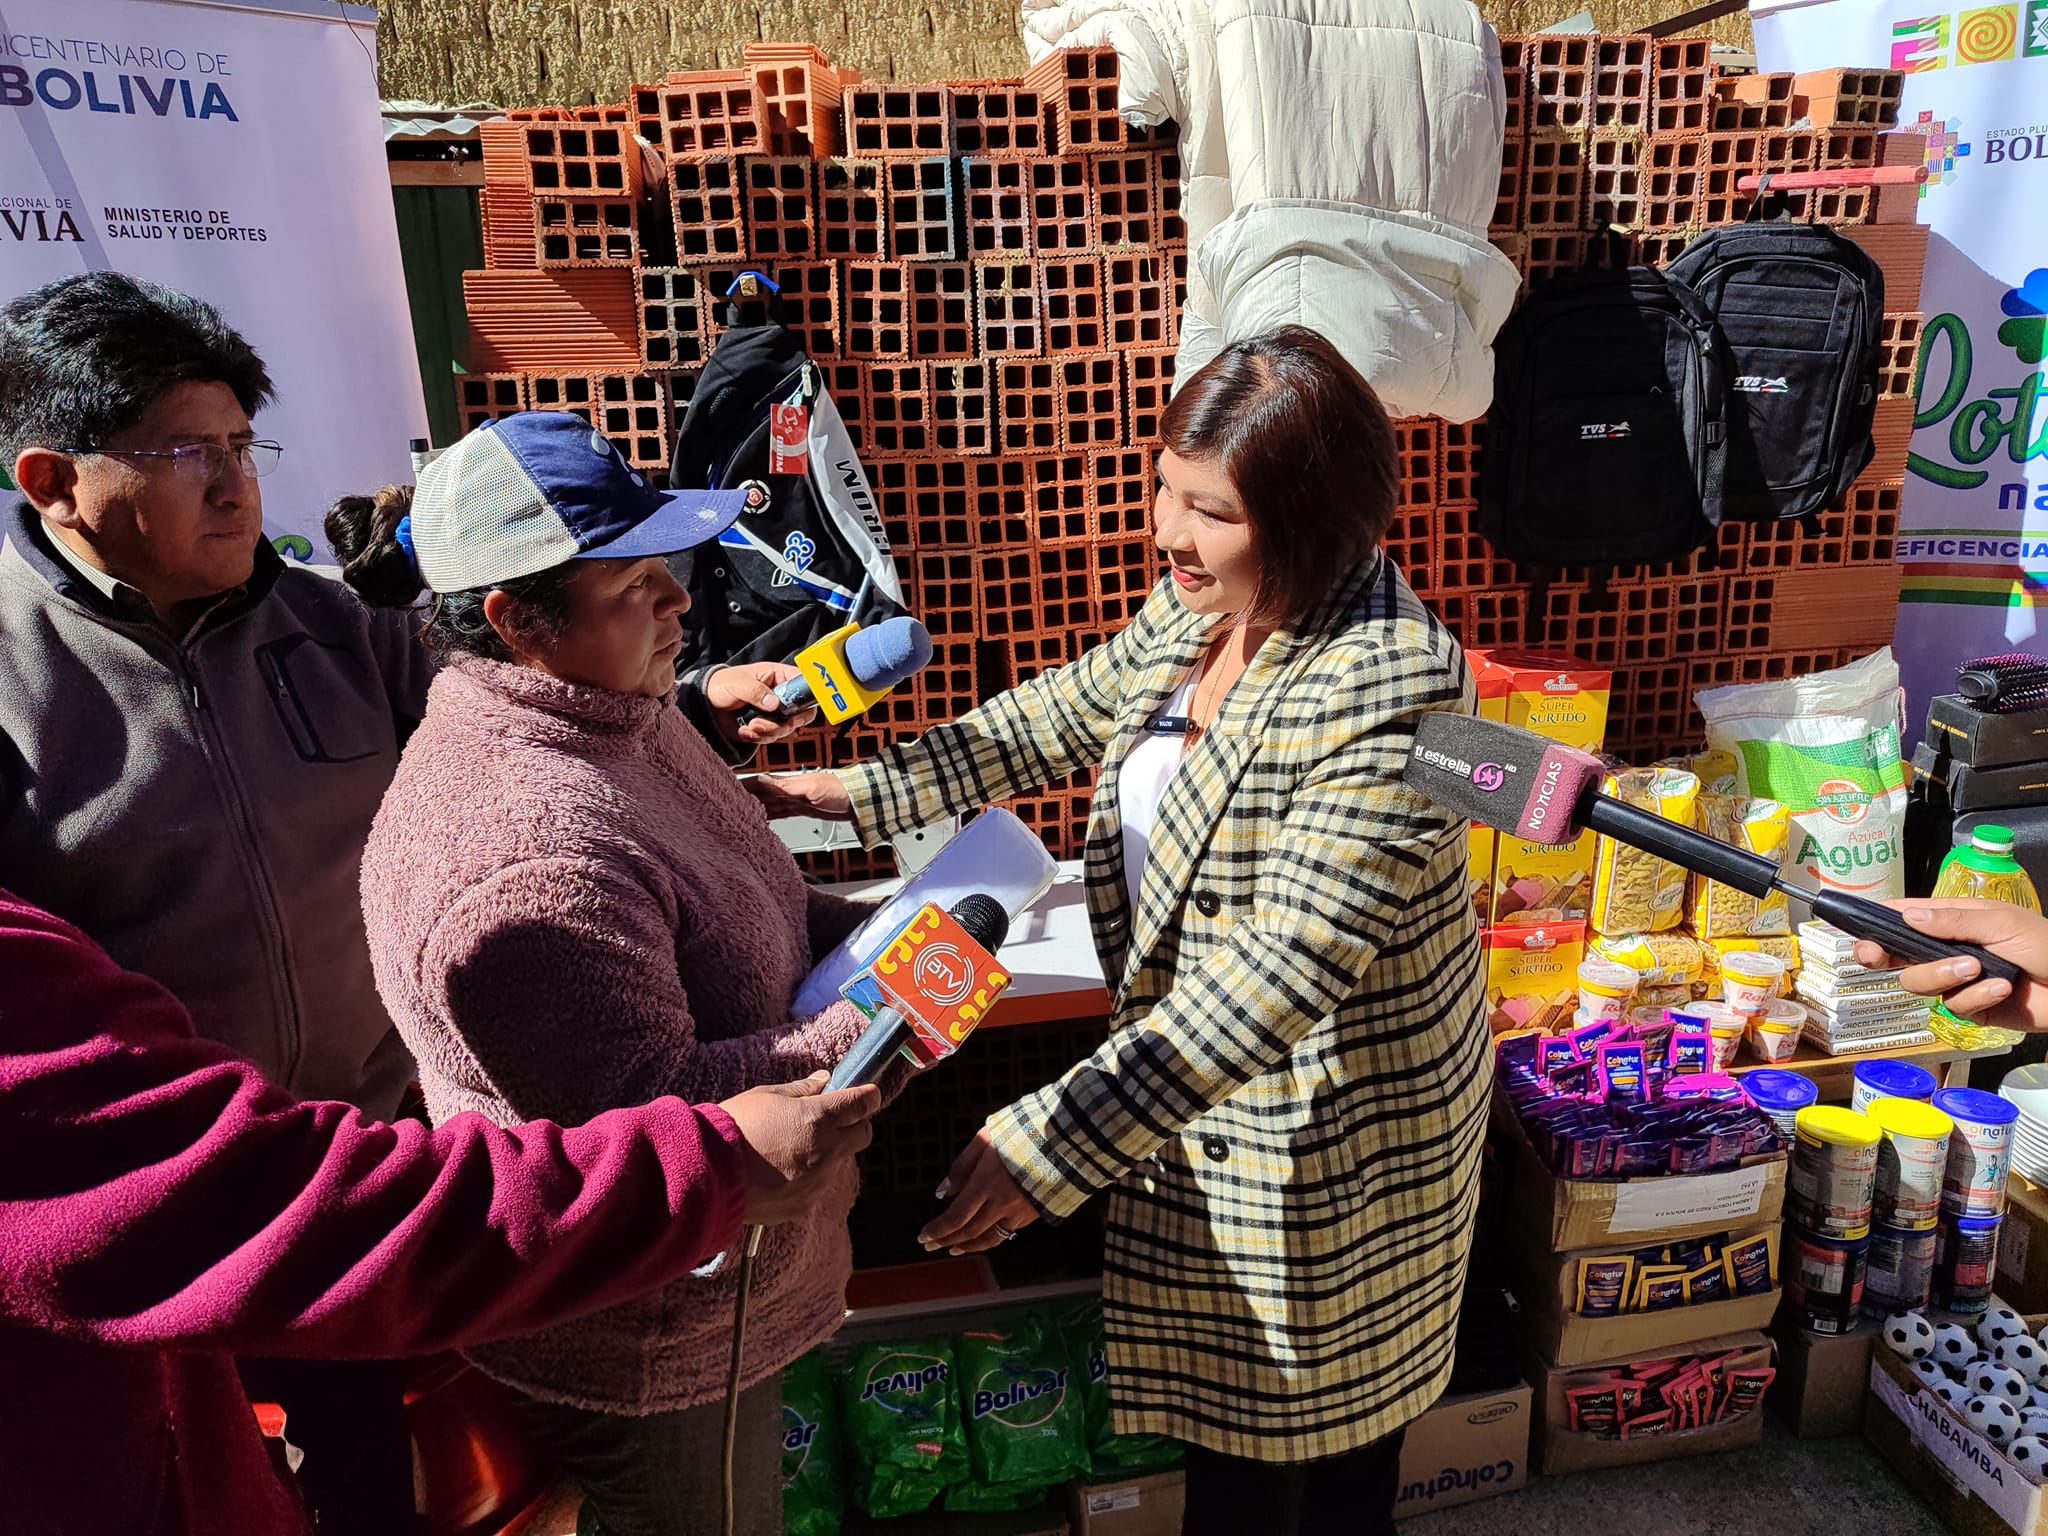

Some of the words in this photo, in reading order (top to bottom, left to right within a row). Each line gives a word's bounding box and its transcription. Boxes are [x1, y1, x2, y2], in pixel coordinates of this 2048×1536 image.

[0, 33, 187, 71] ICENTENARIO
[196, 51, 232, 76] DE
[0, 65, 240, 122] BOLIVIA
[1986, 127, 2026, 139] ESTADO
[0, 197, 51, 209] CIONAL
[55, 198, 73, 209] DE
[103, 207, 202, 224] MINISTERIO
[208, 210, 231, 225] DE
[0, 209, 86, 242] VIA
[107, 224, 163, 240] SALUD
[167, 226, 178, 240] Y
[183, 226, 268, 243] DEPORTES
[1734, 376, 1762, 387] TVS
[1580, 423, 1607, 435] TVS
[812, 661, 849, 713] ATB
[1539, 701, 1575, 712] SUPER
[1529, 712, 1587, 725] SURTIDO
[1424, 748, 1472, 776] estrella
[1527, 760, 1563, 831] NOTICIAS
[1519, 955, 1553, 965] SUPER
[1509, 963, 1563, 978] SURTIDO
[1837, 982, 1885, 995] CHOCOLATE
[1850, 996, 1889, 1007] CHOCOLATE
[1850, 1006, 1892, 1017] CHOCOLATE
[1893, 1000, 1926, 1011] ESPECIAL
[1841, 1018, 1885, 1030] CHOCOLATE
[1886, 1013, 1919, 1023] ESPECIAL
[1835, 1029, 1879, 1040] CHOCOLATE
[1880, 1025, 1903, 1033] EXTRA
[1904, 1022, 1921, 1030] FINO
[1837, 1042, 1885, 1054] CHOCOLATE
[1887, 1037, 1913, 1047] EXTRA
[1914, 1033, 1934, 1043] FINO
[1959, 1120, 2013, 1140] Colnatu
[1733, 1245, 1767, 1266] Colnatur
[1588, 1270, 1624, 1281] Colnatur
[1650, 1287, 1681, 1299] Colnatur
[972, 1365, 1069, 1420] Bolivar
[1397, 1460, 1514, 1503] Colnatur
